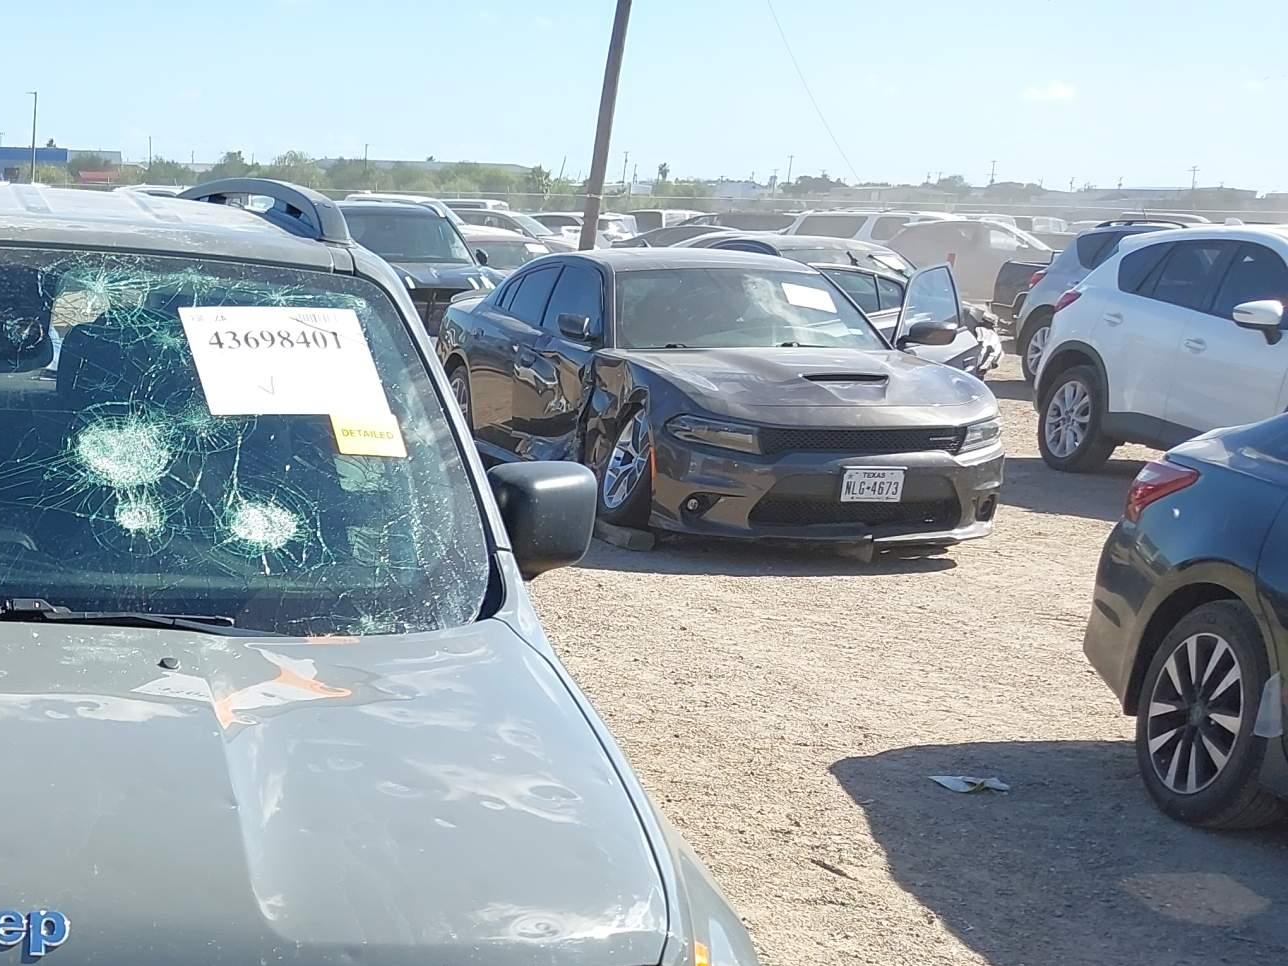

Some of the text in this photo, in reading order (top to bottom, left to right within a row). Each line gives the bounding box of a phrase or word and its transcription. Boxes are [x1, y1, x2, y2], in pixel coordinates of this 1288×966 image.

[208, 330, 342, 350] 43698401
[341, 429, 394, 440] DETAILED
[863, 471, 886, 479] TEXAS
